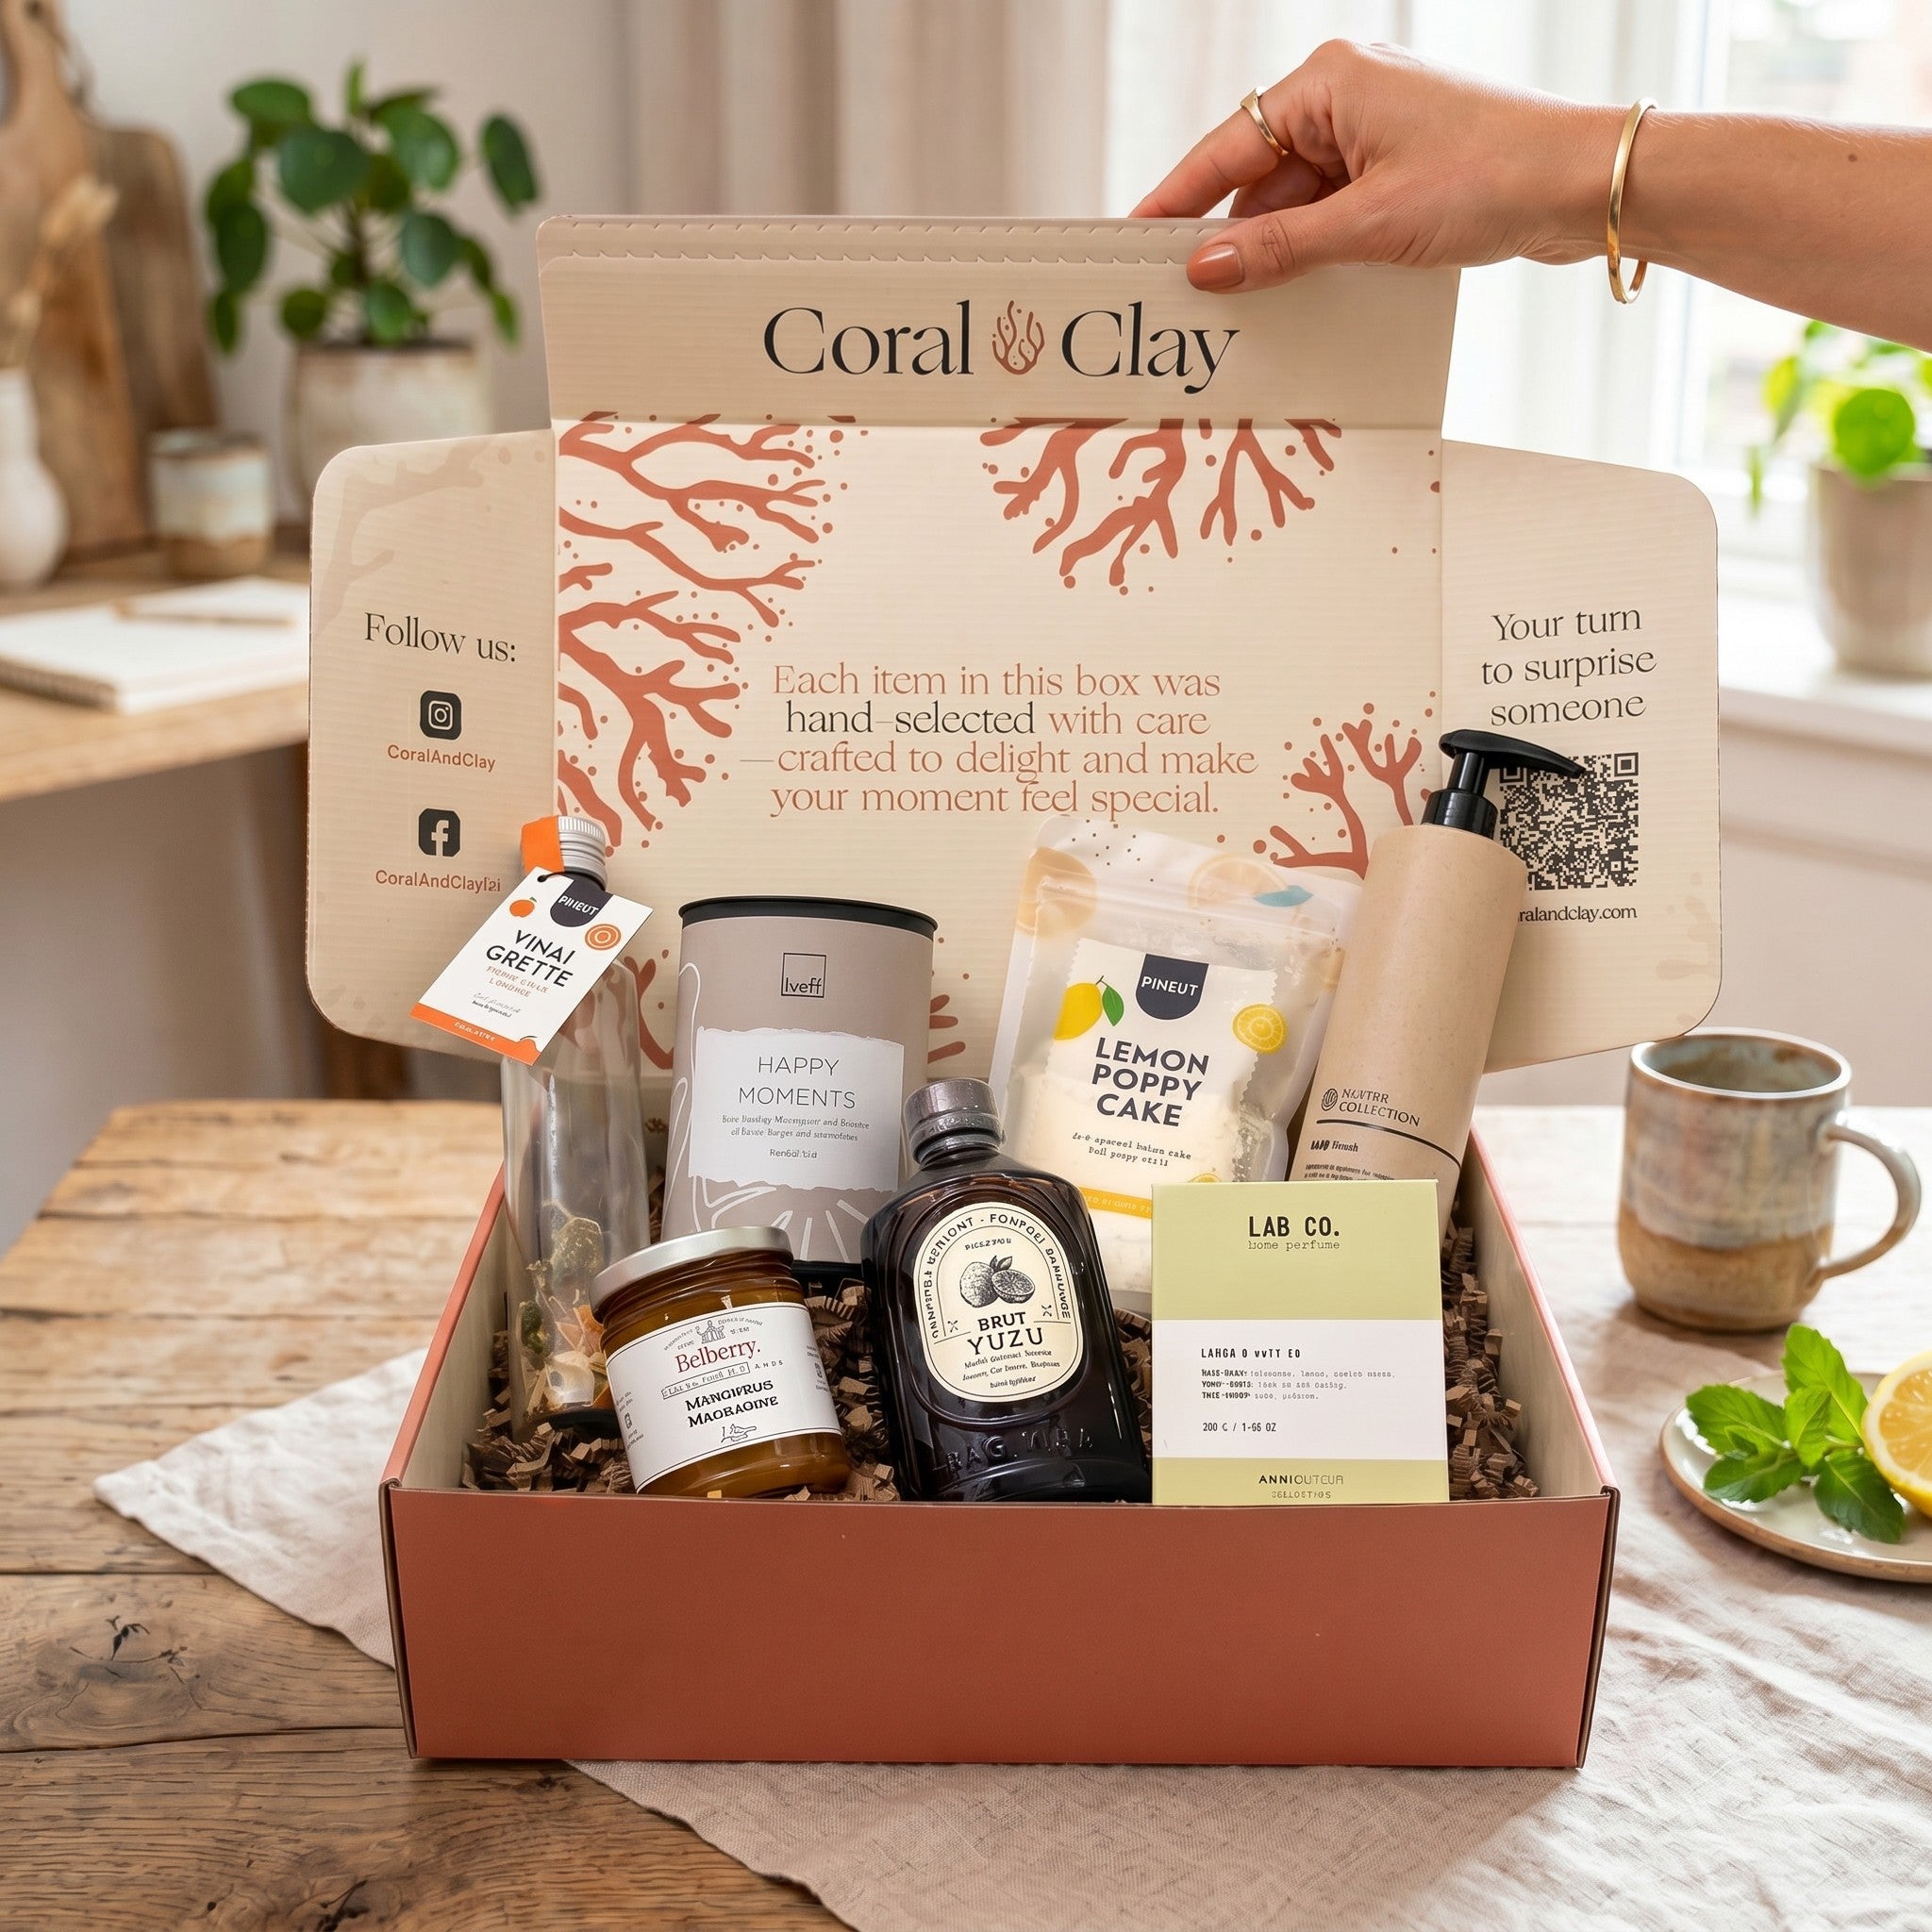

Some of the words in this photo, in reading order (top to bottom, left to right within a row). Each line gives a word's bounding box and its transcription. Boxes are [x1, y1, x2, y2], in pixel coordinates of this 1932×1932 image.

[763, 299, 974, 375] Coral
[1060, 300, 1241, 394] Clay
[364, 612, 466, 655] Follow
[476, 637, 516, 662] us:
[1491, 613, 1563, 641] Your
[1575, 608, 1642, 635] turn
[773, 662, 860, 696] Each
[873, 666, 946, 696] item
[960, 666, 991, 695] in
[1003, 663, 1063, 696] this
[1076, 663, 1141, 696] box
[1152, 673, 1221, 696] was
[1481, 661, 1513, 685] to
[1524, 647, 1657, 687] surprise
[1047, 702, 1123, 735] with
[1136, 712, 1212, 735] care
[1491, 695, 1646, 726] someone
[388, 744, 495, 773] CoralAndClay
[909, 745, 943, 773] to
[956, 741, 1071, 782] delight
[1084, 742, 1147, 774] and
[1161, 741, 1258, 774] make
[770, 787, 849, 818] your
[861, 788, 1009, 812] moment
[1021, 780, 1077, 813] feel
[1091, 780, 1219, 822] special.
[1517, 906, 1637, 923] ralandclay.com
[515, 929, 576, 965] VINAI
[486, 945, 574, 988] GRETTE
[1141, 975, 1199, 997] PINEUT
[758, 1056, 841, 1076] HAPPY
[1095, 1036, 1210, 1076] LEMON
[1091, 1062, 1203, 1102] POPPY
[739, 1087, 856, 1110] MOMENTS
[1096, 1092, 1184, 1127] CAKE
[1340, 1101, 1421, 1127] COLLECTION
[795, 1129, 811, 1139] and
[823, 1119, 838, 1127] and
[1168, 1150, 1192, 1160] cake
[1248, 1216, 1291, 1238] LAB
[1305, 1216, 1341, 1238] CO.
[1286, 1240, 1341, 1252] perfume
[977, 1311, 1026, 1331] BRUT
[967, 1326, 1044, 1356] YUZU
[674, 1340, 761, 1374] Belberry.
[1203, 1423, 1218, 1432] 200
[1232, 1423, 1237, 1432] /
